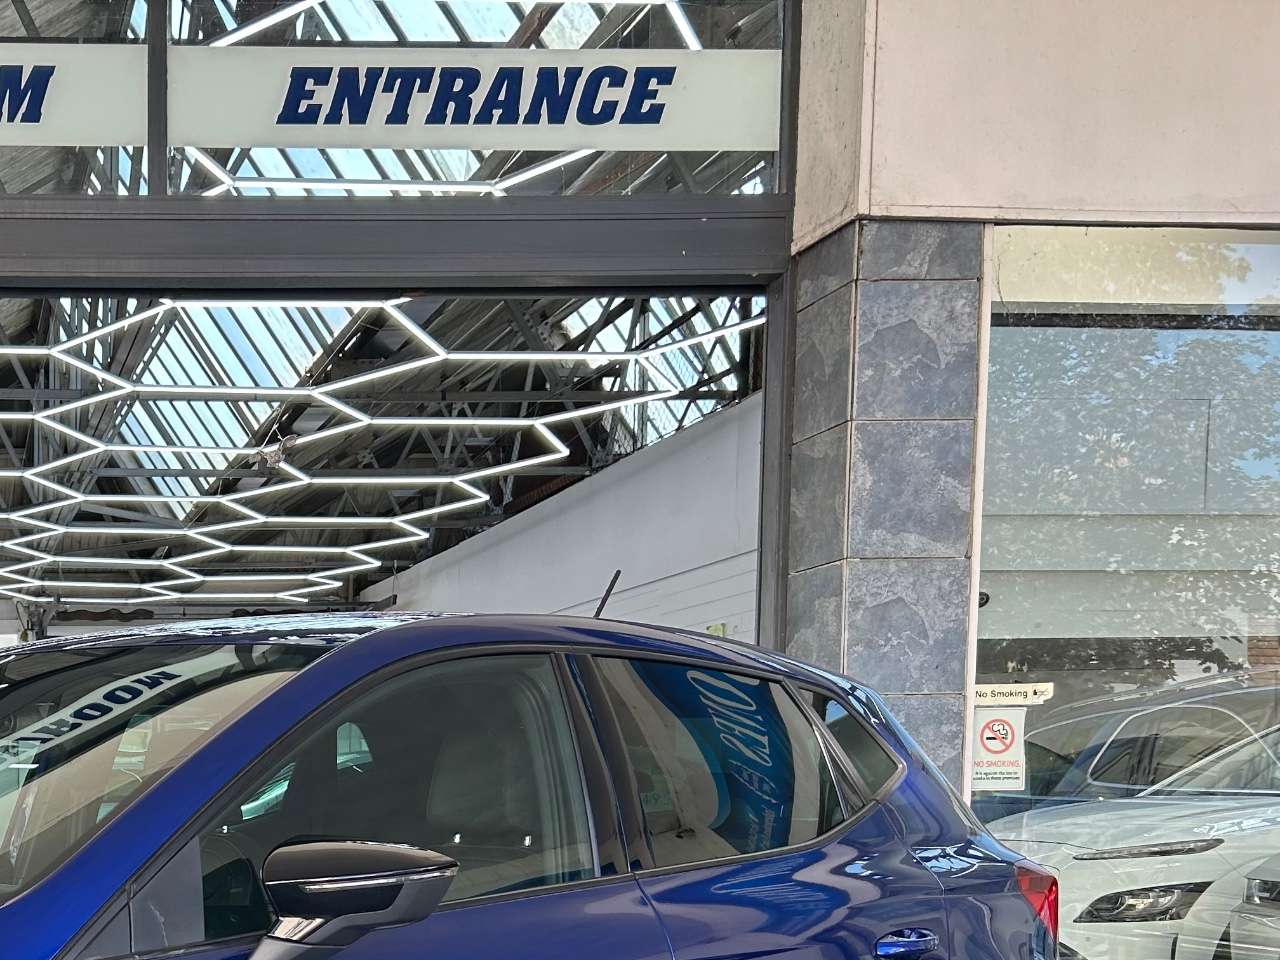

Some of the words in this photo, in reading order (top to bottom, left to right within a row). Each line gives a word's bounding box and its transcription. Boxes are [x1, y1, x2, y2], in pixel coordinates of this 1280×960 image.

[275, 65, 678, 126] ENTRANCE
[975, 690, 988, 698] No
[990, 689, 1028, 698] Smoking
[974, 760, 985, 768] NO
[985, 760, 1021, 768] SMOKING
